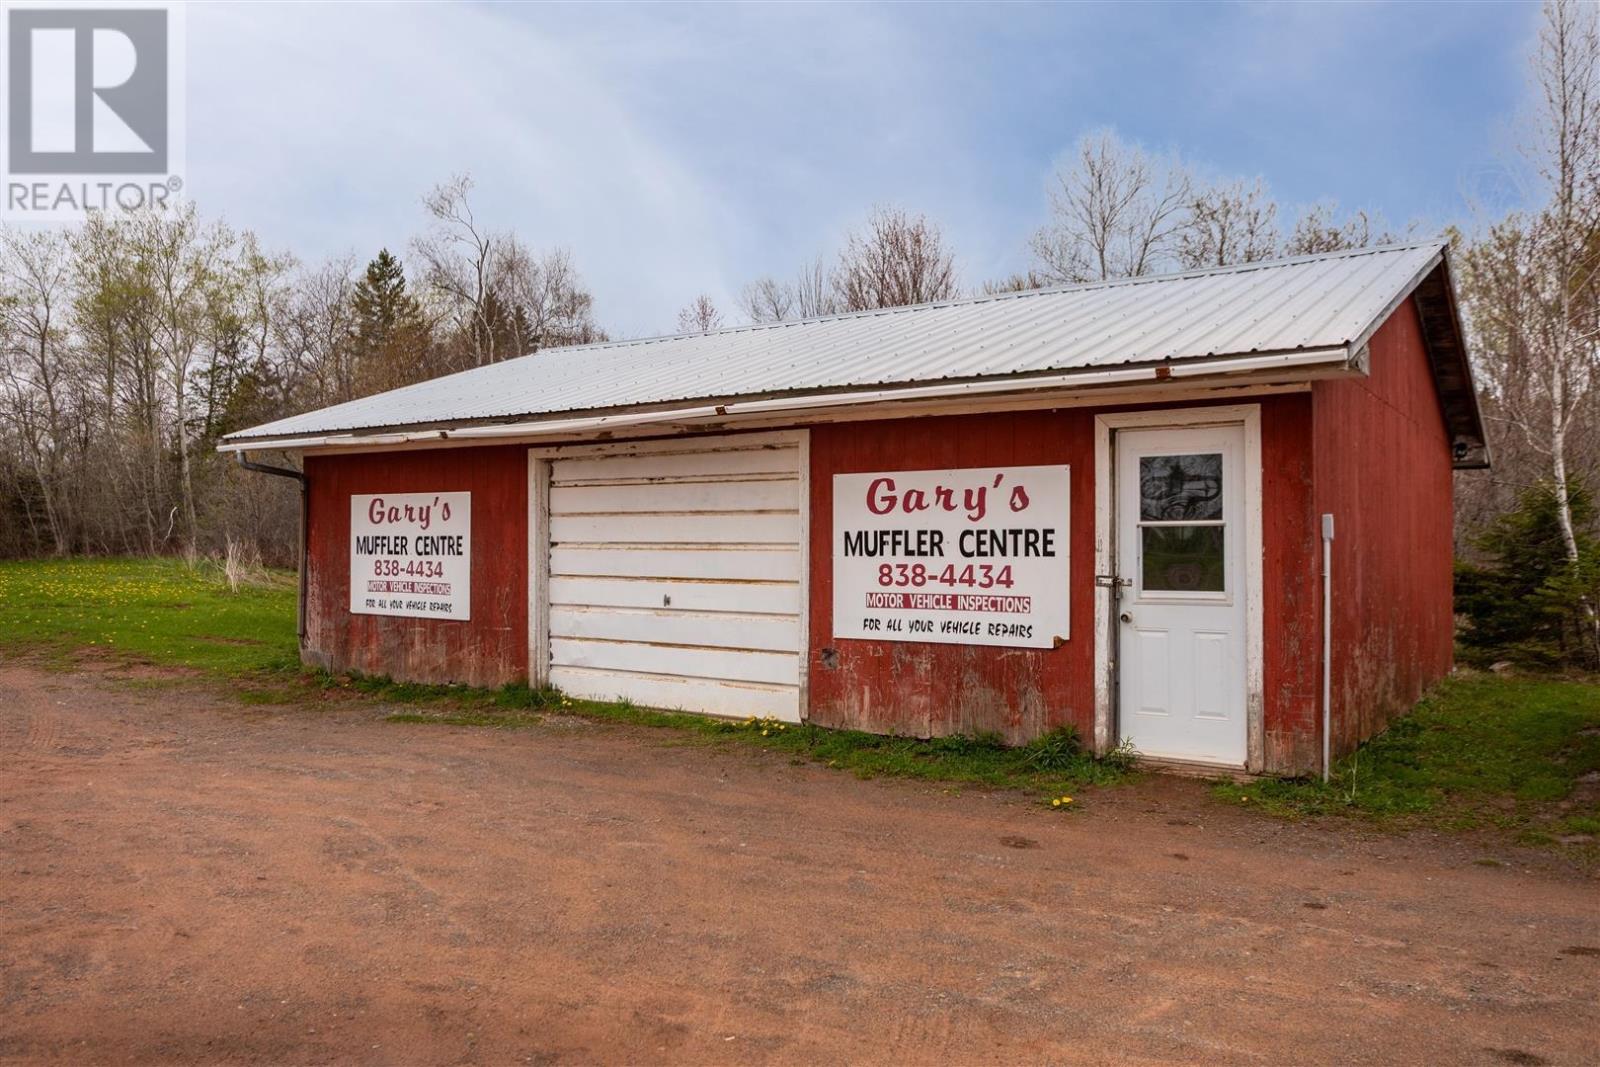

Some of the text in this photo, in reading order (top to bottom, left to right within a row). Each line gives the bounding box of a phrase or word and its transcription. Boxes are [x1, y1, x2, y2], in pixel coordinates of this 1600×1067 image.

[866, 473, 1030, 522] Gary's
[368, 496, 451, 530] Gary's
[356, 535, 463, 556] MUFFLER CENTRE
[844, 528, 1056, 558] MUFFLER CENTRE
[374, 559, 443, 578] 838-4434
[878, 563, 1014, 589] 838-4434
[367, 581, 451, 595] MOTOR VEHICLE INSPECTIONS
[365, 599, 452, 613] FOR ALL YOUR VEHICLE REPAIRS
[866, 593, 1031, 613] MOTOR VEHICLE INSPECTIONS
[863, 618, 1033, 639] FOR ALL YOUR VEHICLE REPAIRS
